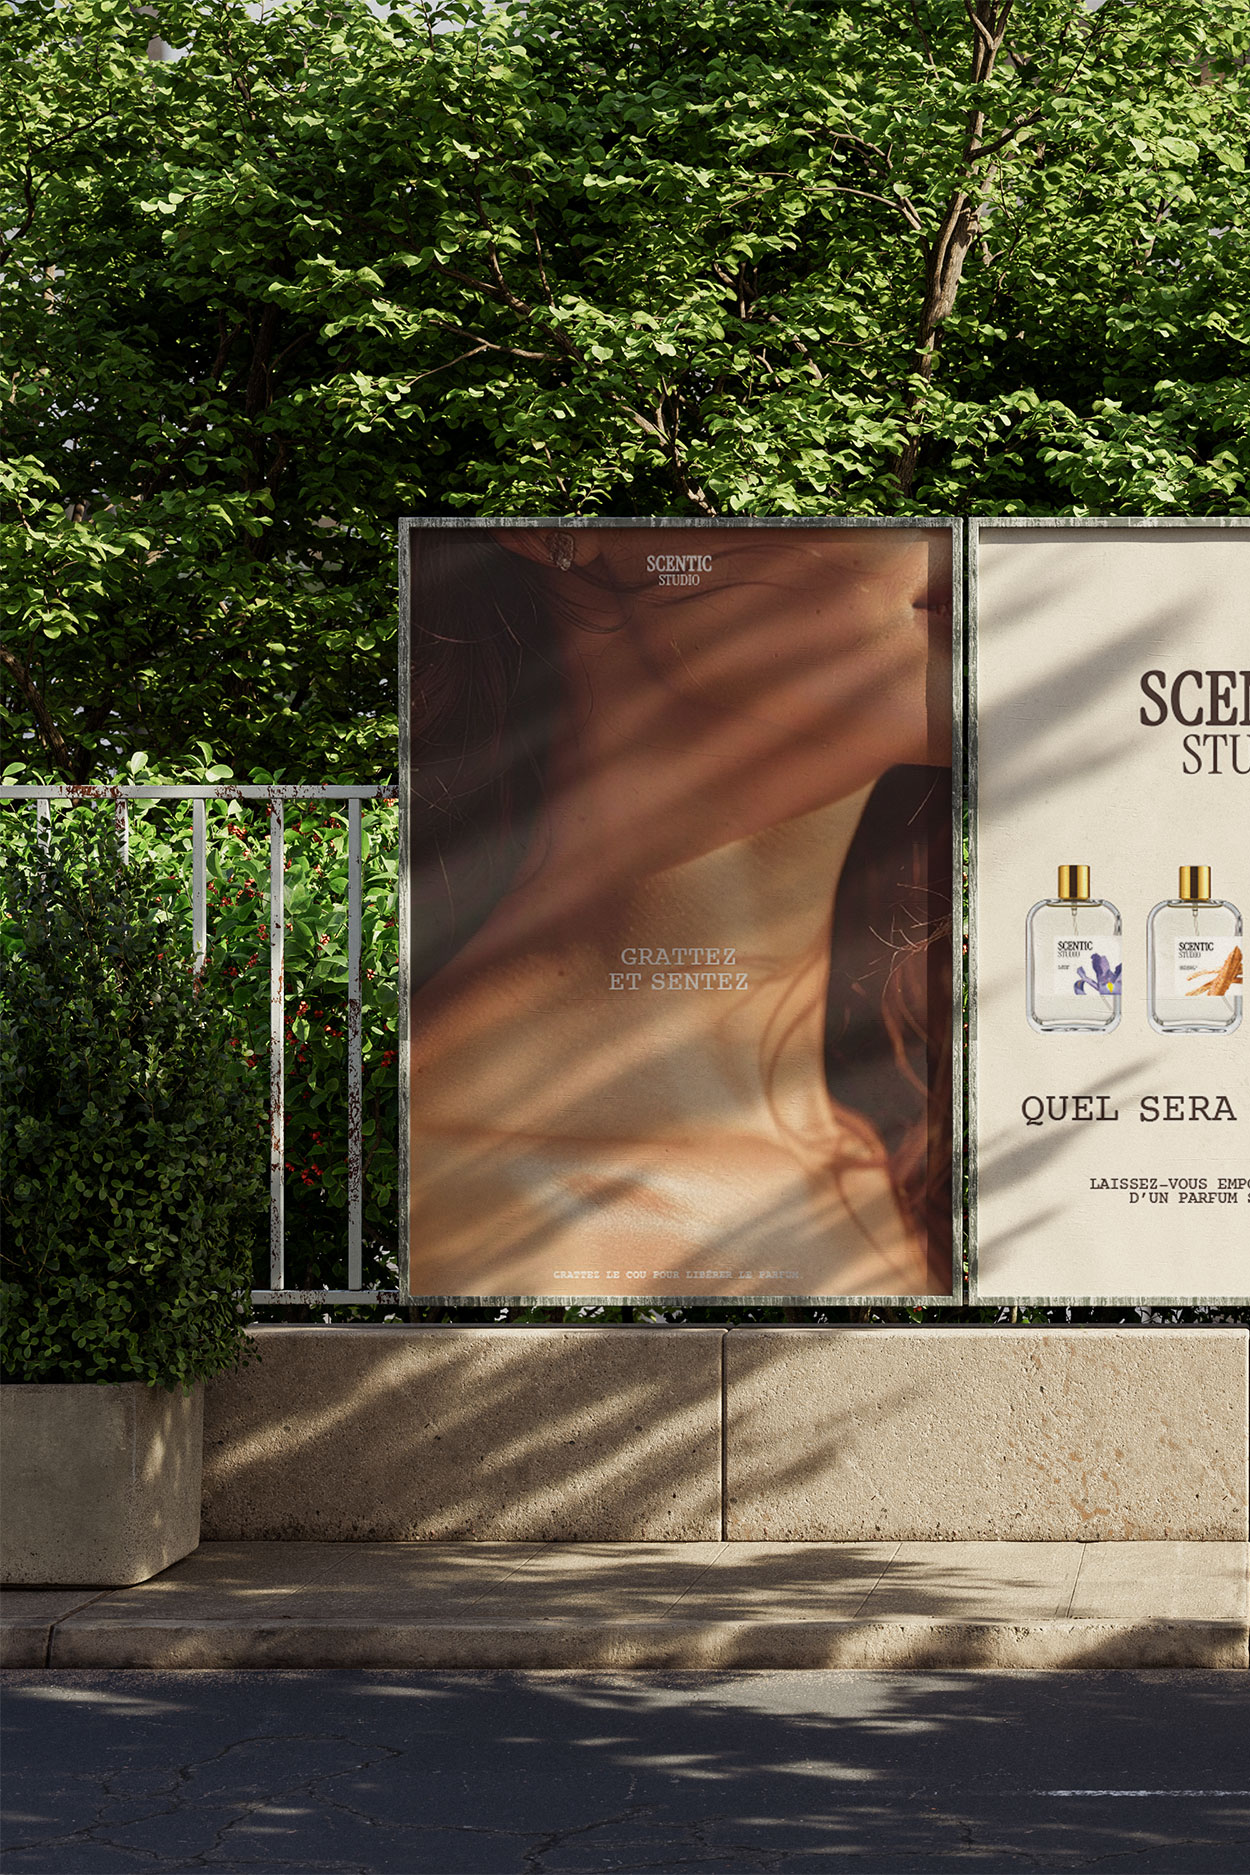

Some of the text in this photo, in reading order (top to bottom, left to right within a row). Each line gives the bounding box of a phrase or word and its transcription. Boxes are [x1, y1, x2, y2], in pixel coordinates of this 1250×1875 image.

[647, 555, 712, 573] SCENTIC
[658, 574, 700, 586] STUDIO
[1057, 941, 1093, 951] SCENTIC
[1179, 942, 1214, 951] SCENTIC
[621, 948, 737, 966] GRATTEZ
[609, 972, 749, 991] ET SENTEZ
[1021, 1095, 1118, 1126] QUEL
[1140, 1095, 1236, 1122] SERA
[1089, 1178, 1208, 1190] LAISSEZ-VOUS
[1179, 1192, 1238, 1204] PARFUM
[554, 1271, 600, 1279] GRATTEZ
[606, 1271, 620, 1279] LE
[626, 1271, 646, 1279] COU
[653, 1271, 680, 1279] POUR
[738, 1271, 752, 1279] LE
